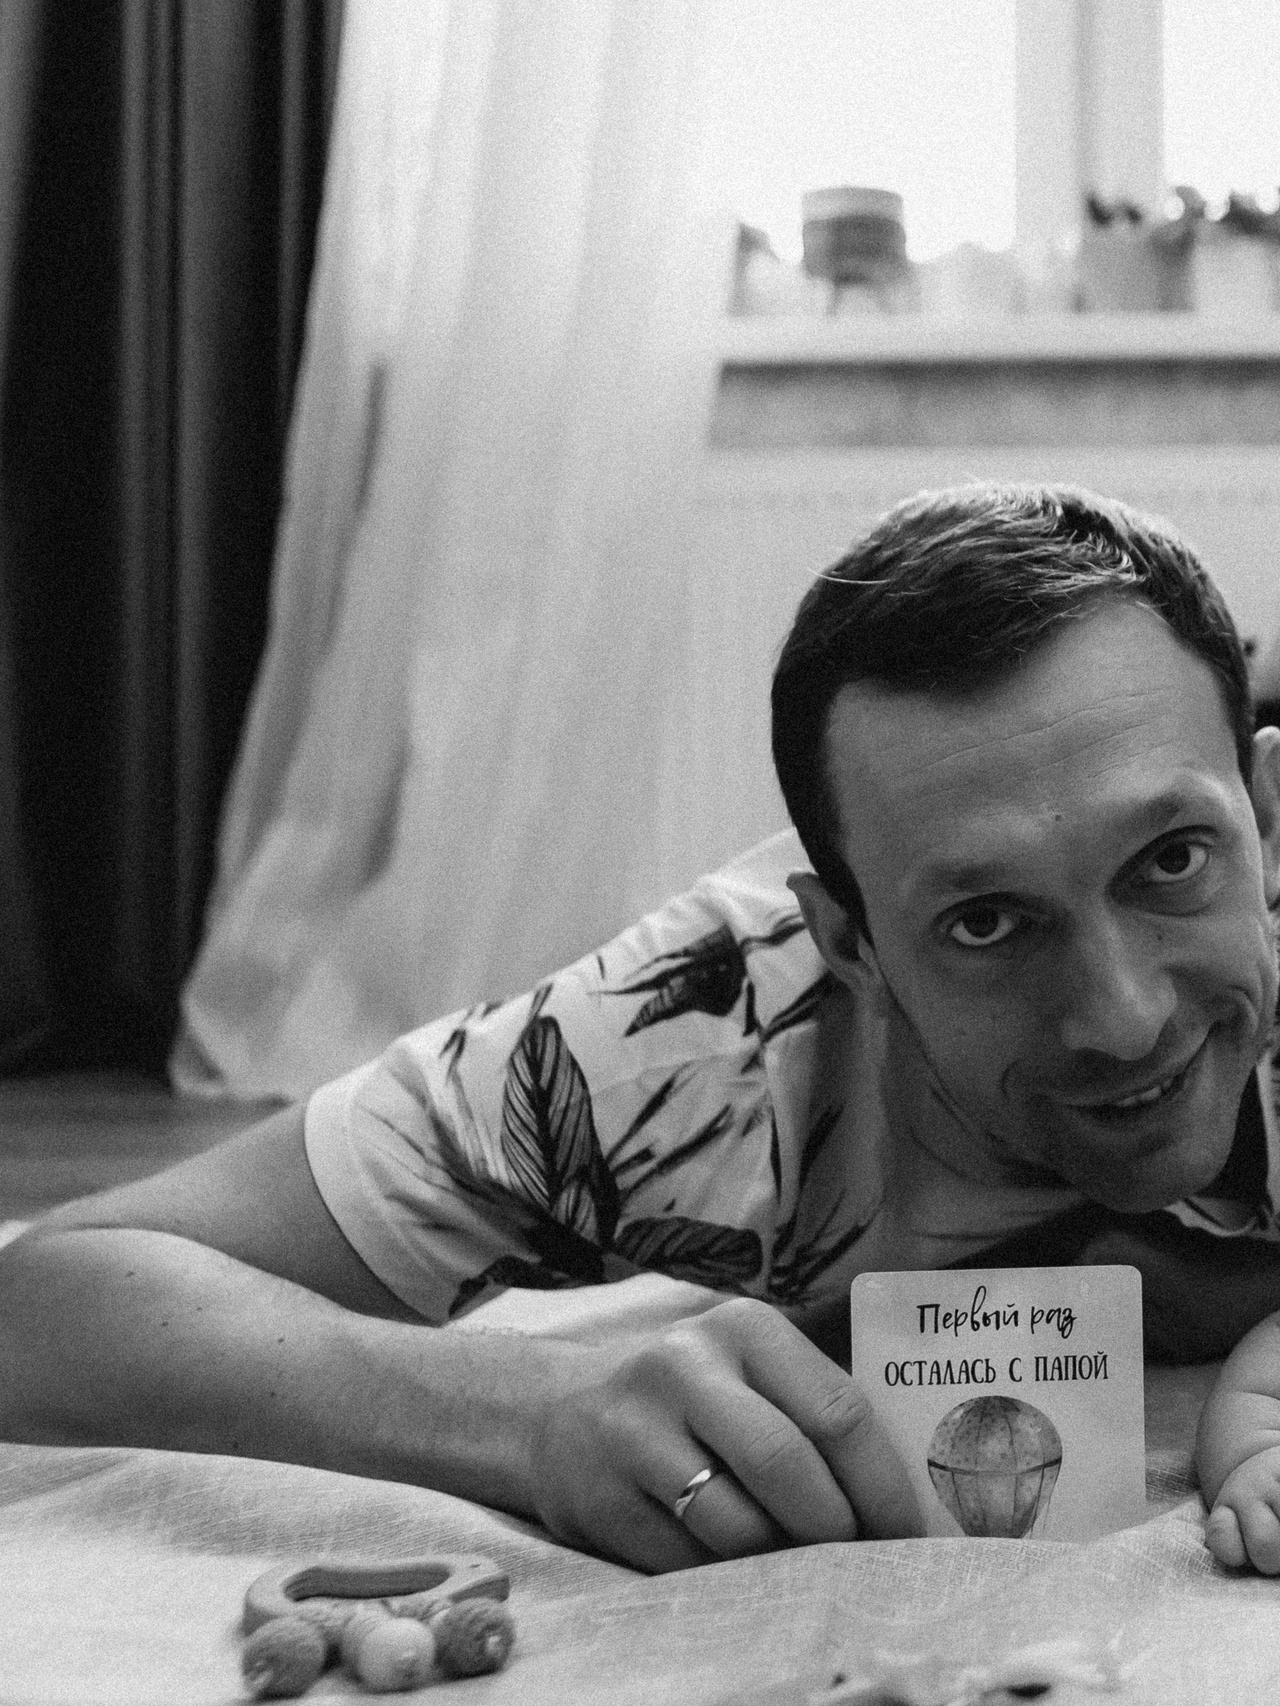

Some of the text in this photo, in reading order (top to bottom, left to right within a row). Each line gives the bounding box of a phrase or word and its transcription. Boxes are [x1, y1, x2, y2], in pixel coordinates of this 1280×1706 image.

[916, 1285, 1077, 1339] Первый раз
[884, 1351, 1109, 1386] ОСТАЛАСЬ С ПАПОЙ
